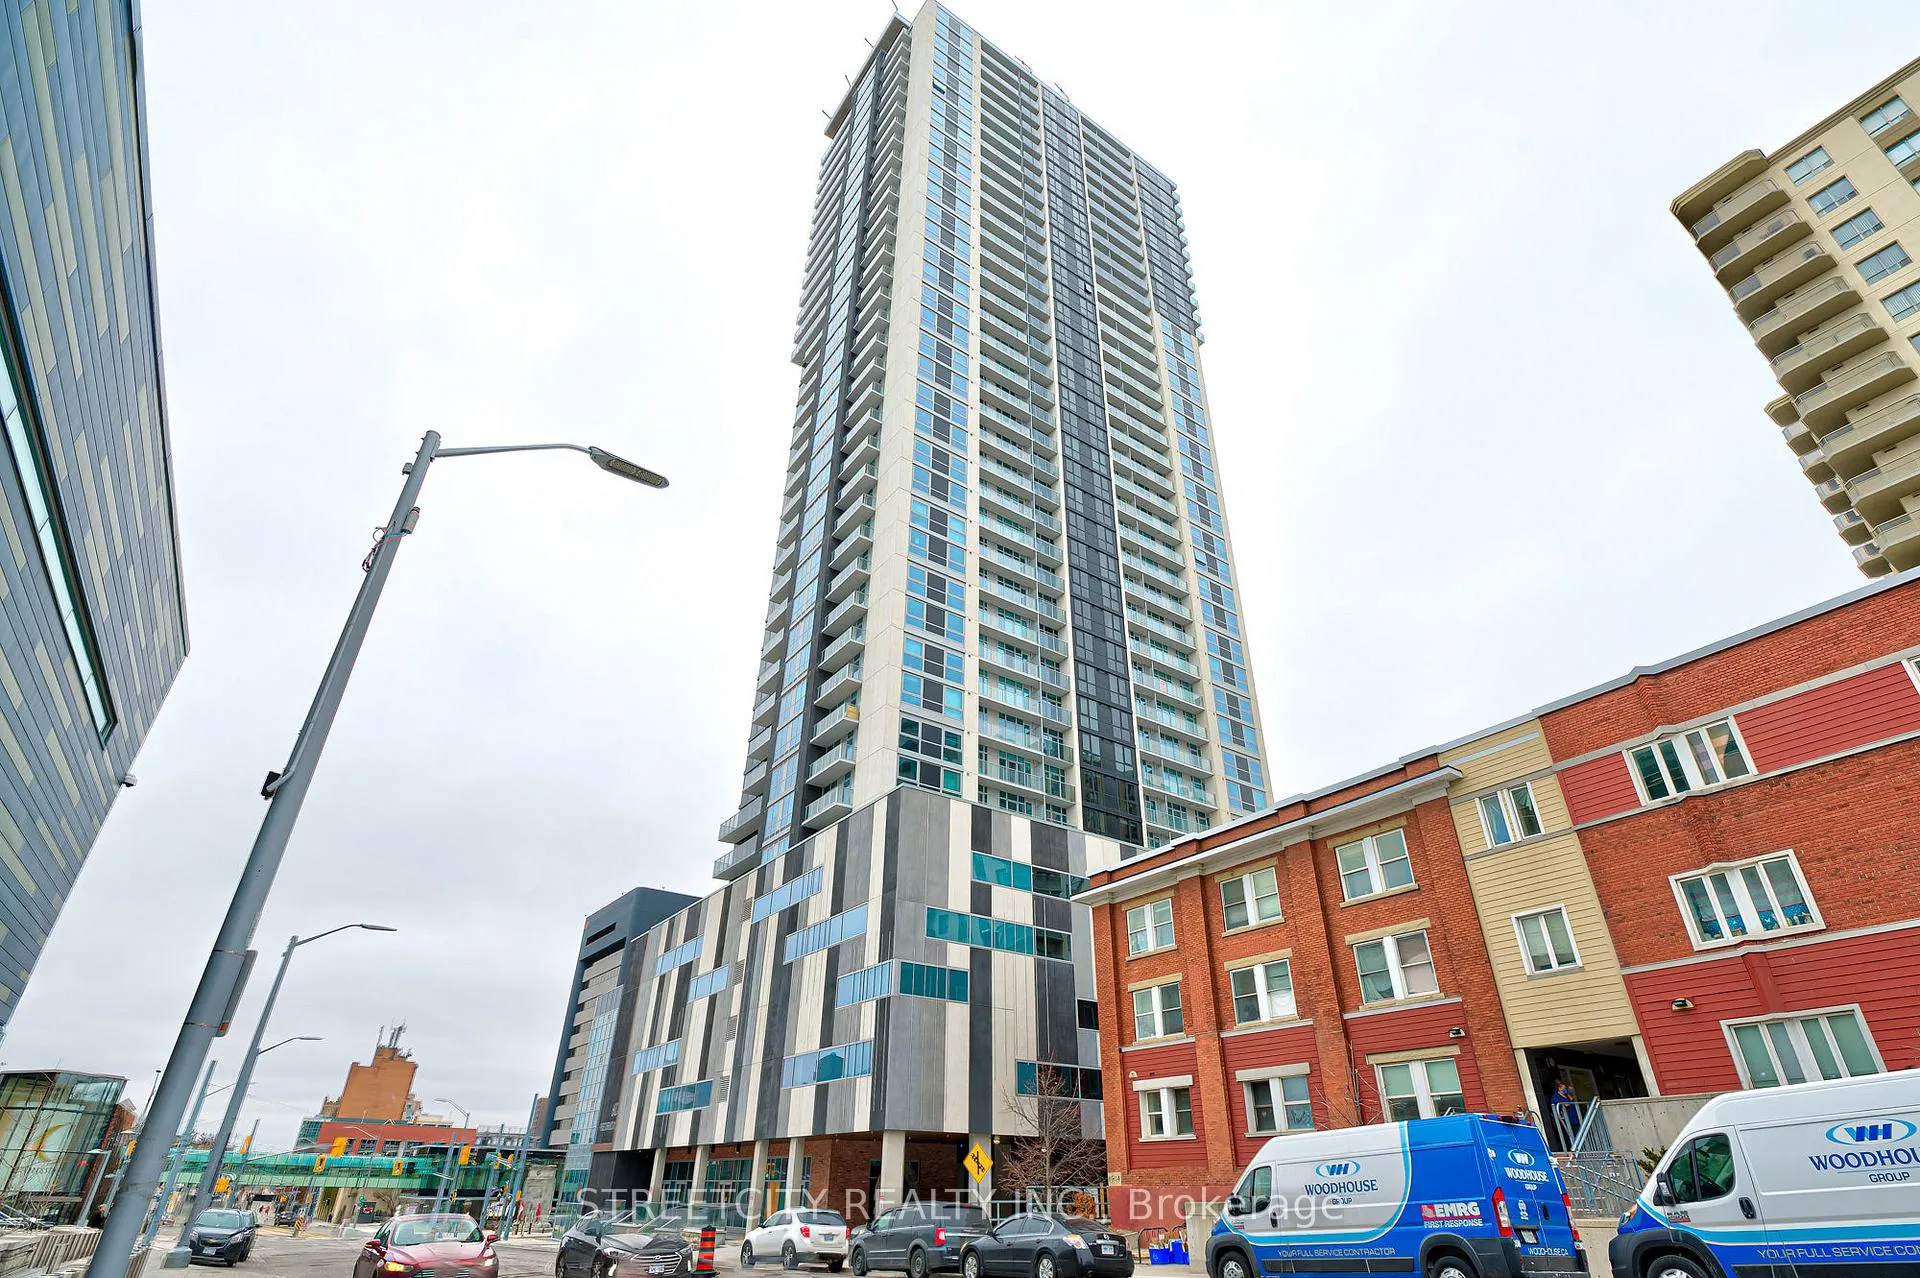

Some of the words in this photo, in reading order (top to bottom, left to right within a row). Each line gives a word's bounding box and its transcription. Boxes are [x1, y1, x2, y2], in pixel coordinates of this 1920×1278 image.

[1503, 1166, 1549, 1182] WOODHOUSE
[1868, 1171, 1910, 1183] GROUP
[1304, 1179, 1378, 1196] WOODHOUSE
[1433, 1201, 1481, 1218] EMRG
[1444, 1218, 1484, 1228] RESPONSE
[1314, 1248, 1343, 1257] SERVICE
[1343, 1247, 1396, 1256] CONTRACTOR
[1757, 1248, 1797, 1259] YOUR
[1796, 1248, 1831, 1258] FULL
[1831, 1245, 1893, 1257] SERVICE
